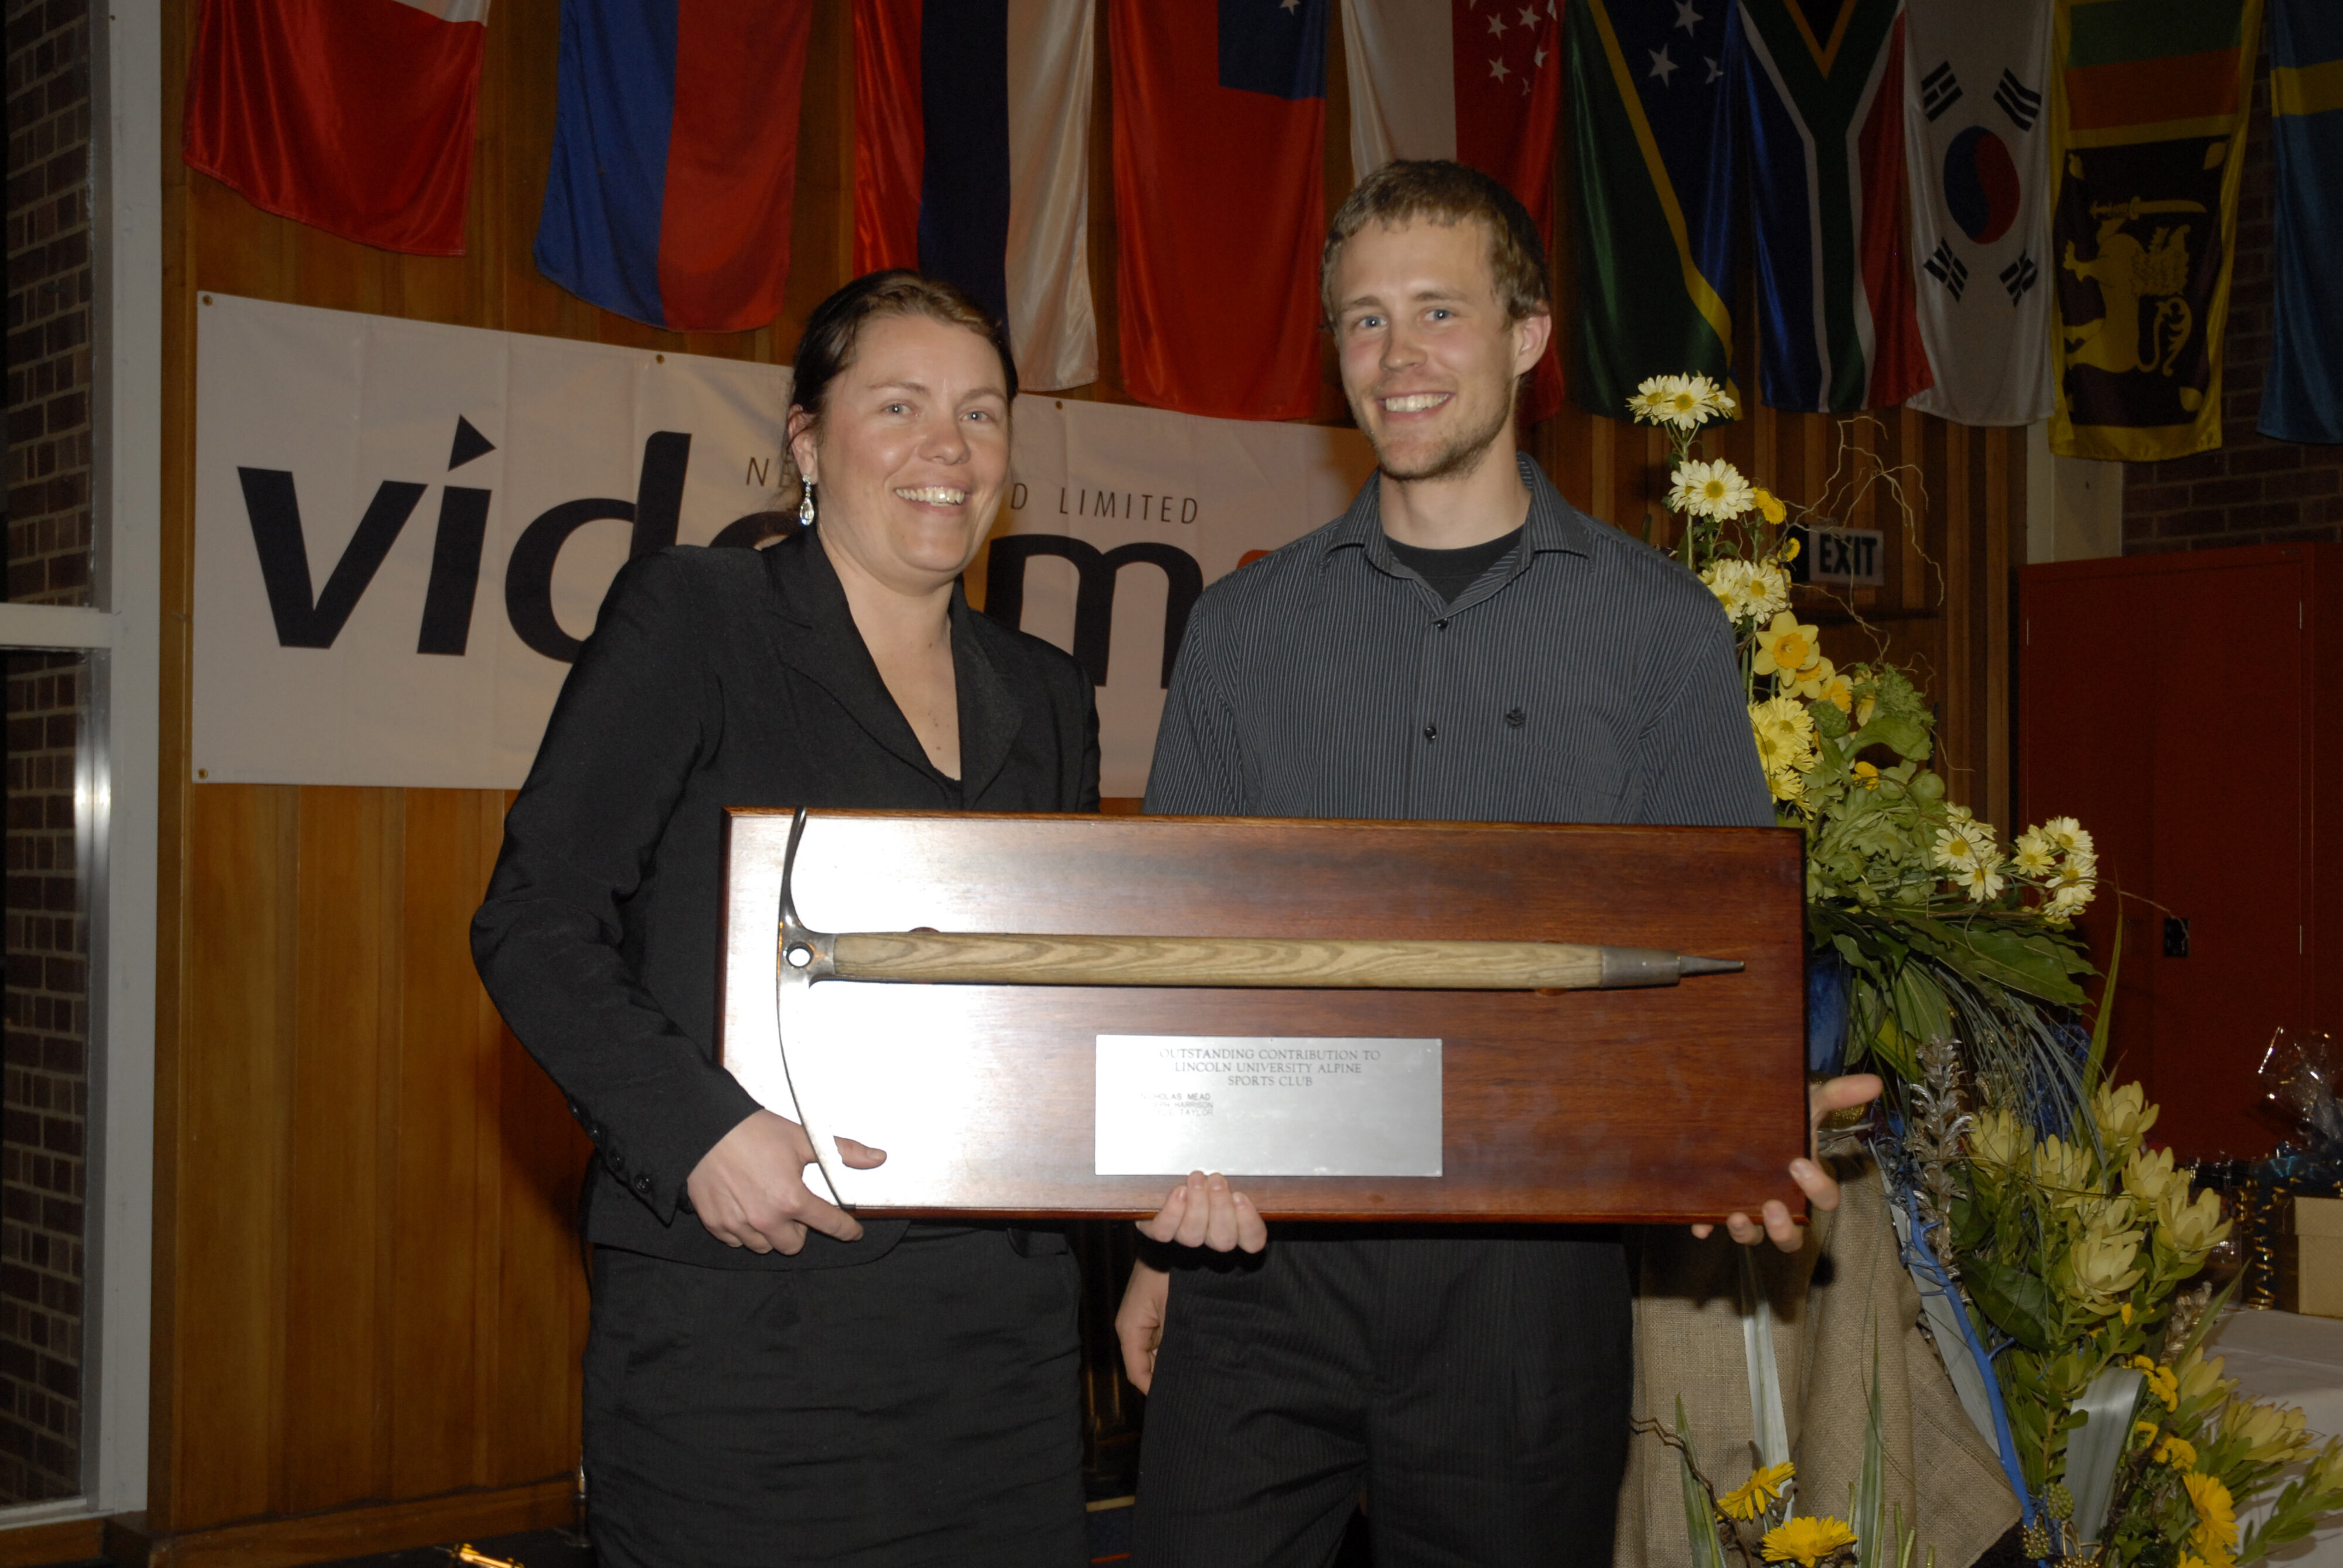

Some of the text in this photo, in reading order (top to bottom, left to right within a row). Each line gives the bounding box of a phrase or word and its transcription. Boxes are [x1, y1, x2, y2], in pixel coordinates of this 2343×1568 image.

[1059, 487, 1198, 524] LIMITED
[1819, 534, 1877, 576] EXIT
[1159, 1048, 1381, 1061] OUTSTANDING CONTRIBUTION TO
[1175, 1061, 1362, 1074] LINCOLN UNIVERSITY ALPINE
[1227, 1075, 1314, 1087] SPORTS CLUB
